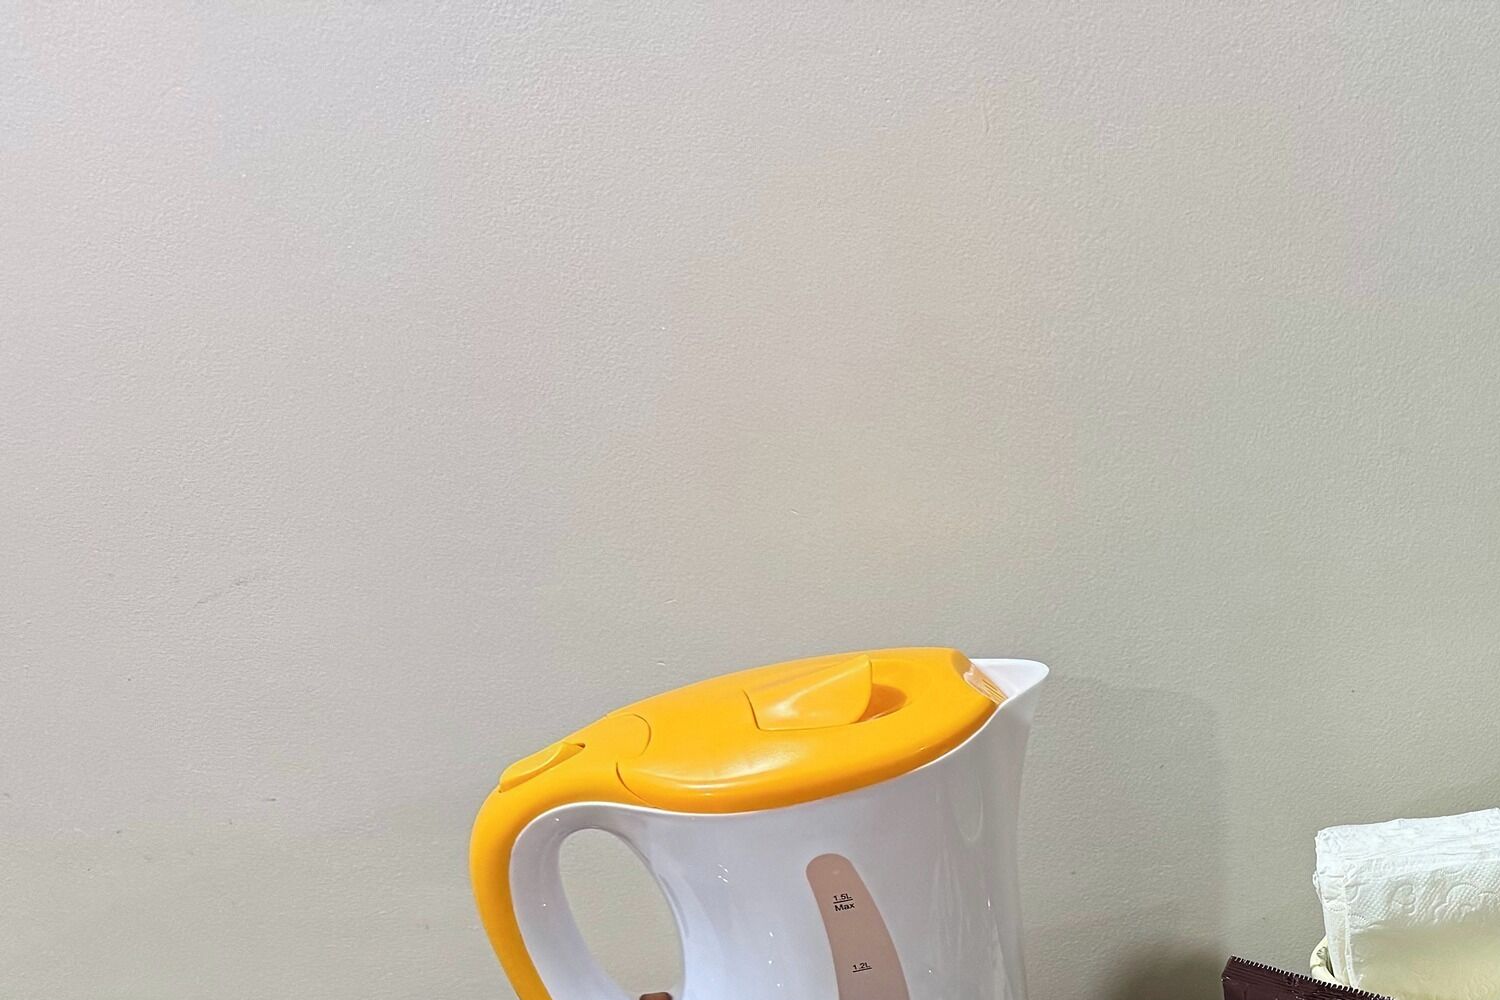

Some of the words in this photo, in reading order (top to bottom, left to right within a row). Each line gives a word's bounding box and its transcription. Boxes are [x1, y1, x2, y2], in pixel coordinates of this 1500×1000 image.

[833, 893, 852, 902] 1.5L
[834, 902, 855, 912] Max
[852, 962, 871, 970] 1.2L
